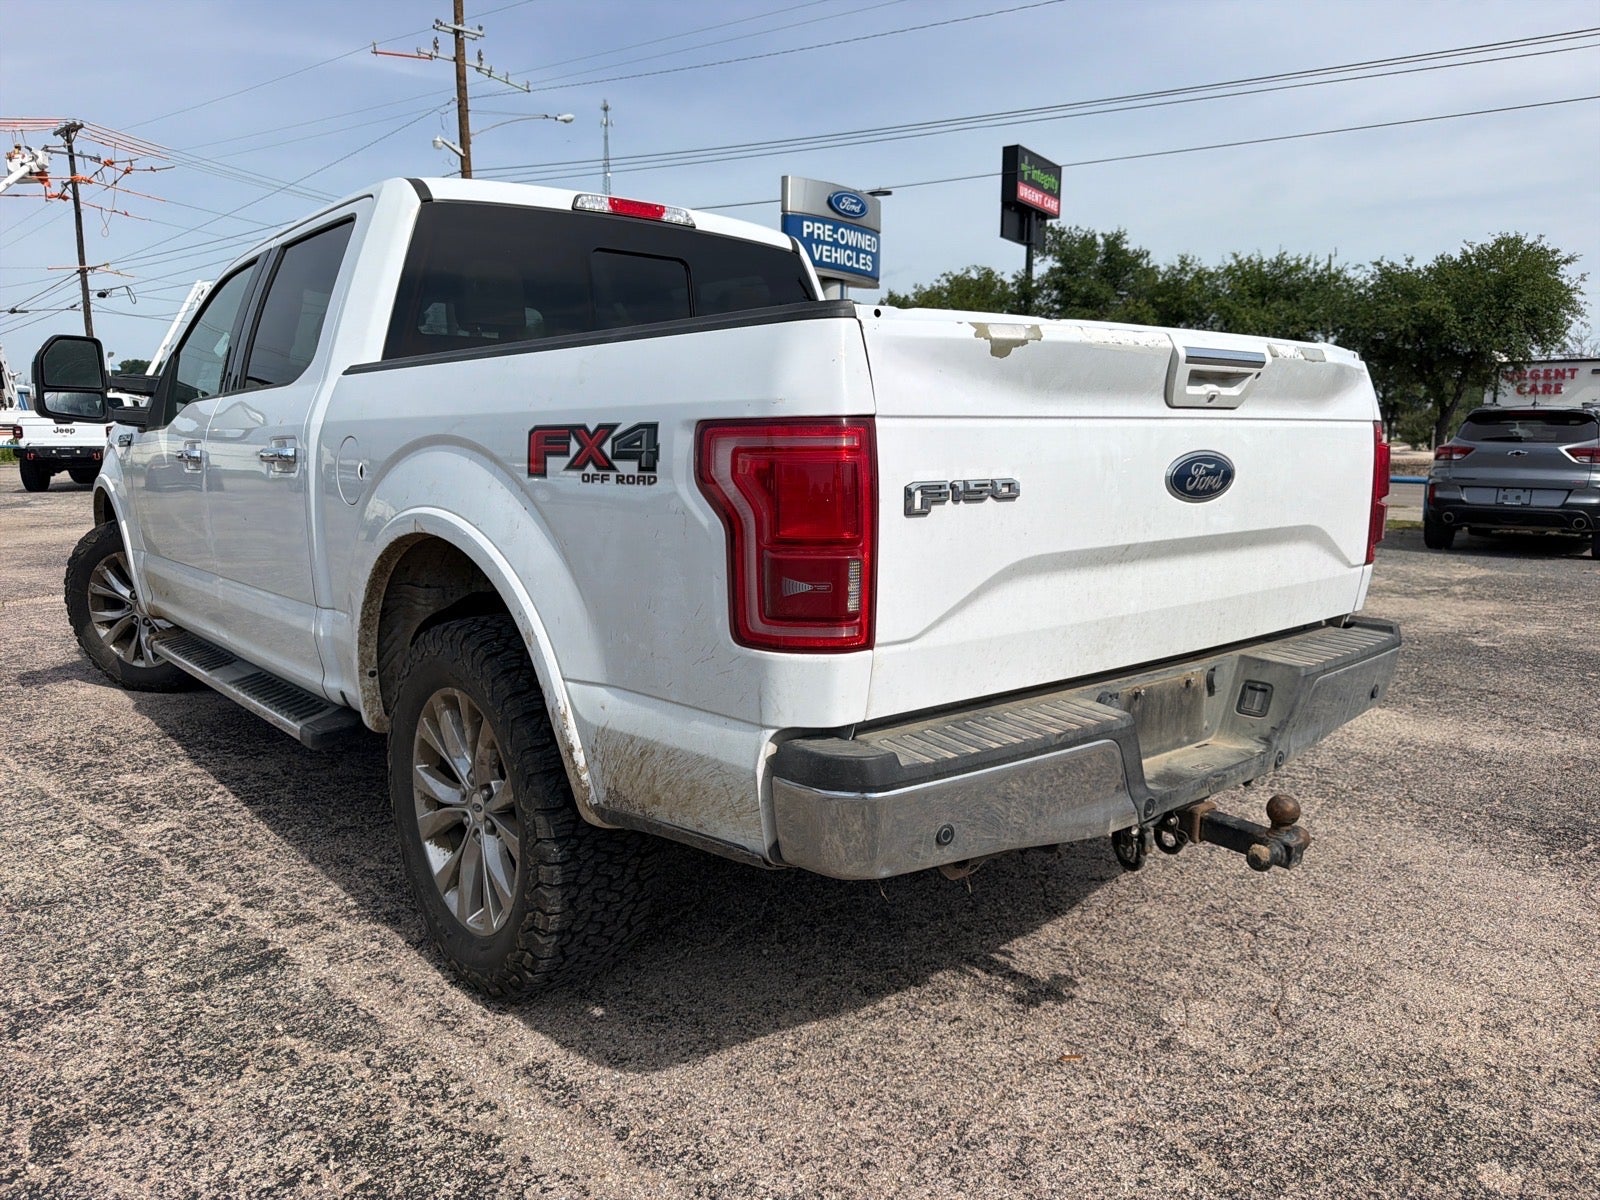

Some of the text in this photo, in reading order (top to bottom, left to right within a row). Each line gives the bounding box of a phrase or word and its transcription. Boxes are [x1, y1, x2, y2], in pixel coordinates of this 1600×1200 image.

[1032, 165, 1058, 194] integrity
[839, 196, 862, 214] Ford
[1019, 185, 1058, 212] URGENT CARE
[802, 220, 878, 253] PRE-OWNED
[812, 243, 873, 272] VEHICLES
[1516, 383, 1564, 396] CARE
[53, 426, 76, 435] Jeep
[527, 421, 660, 479] FX4
[581, 472, 658, 486] OFF ROAD
[1186, 462, 1225, 491] Ford
